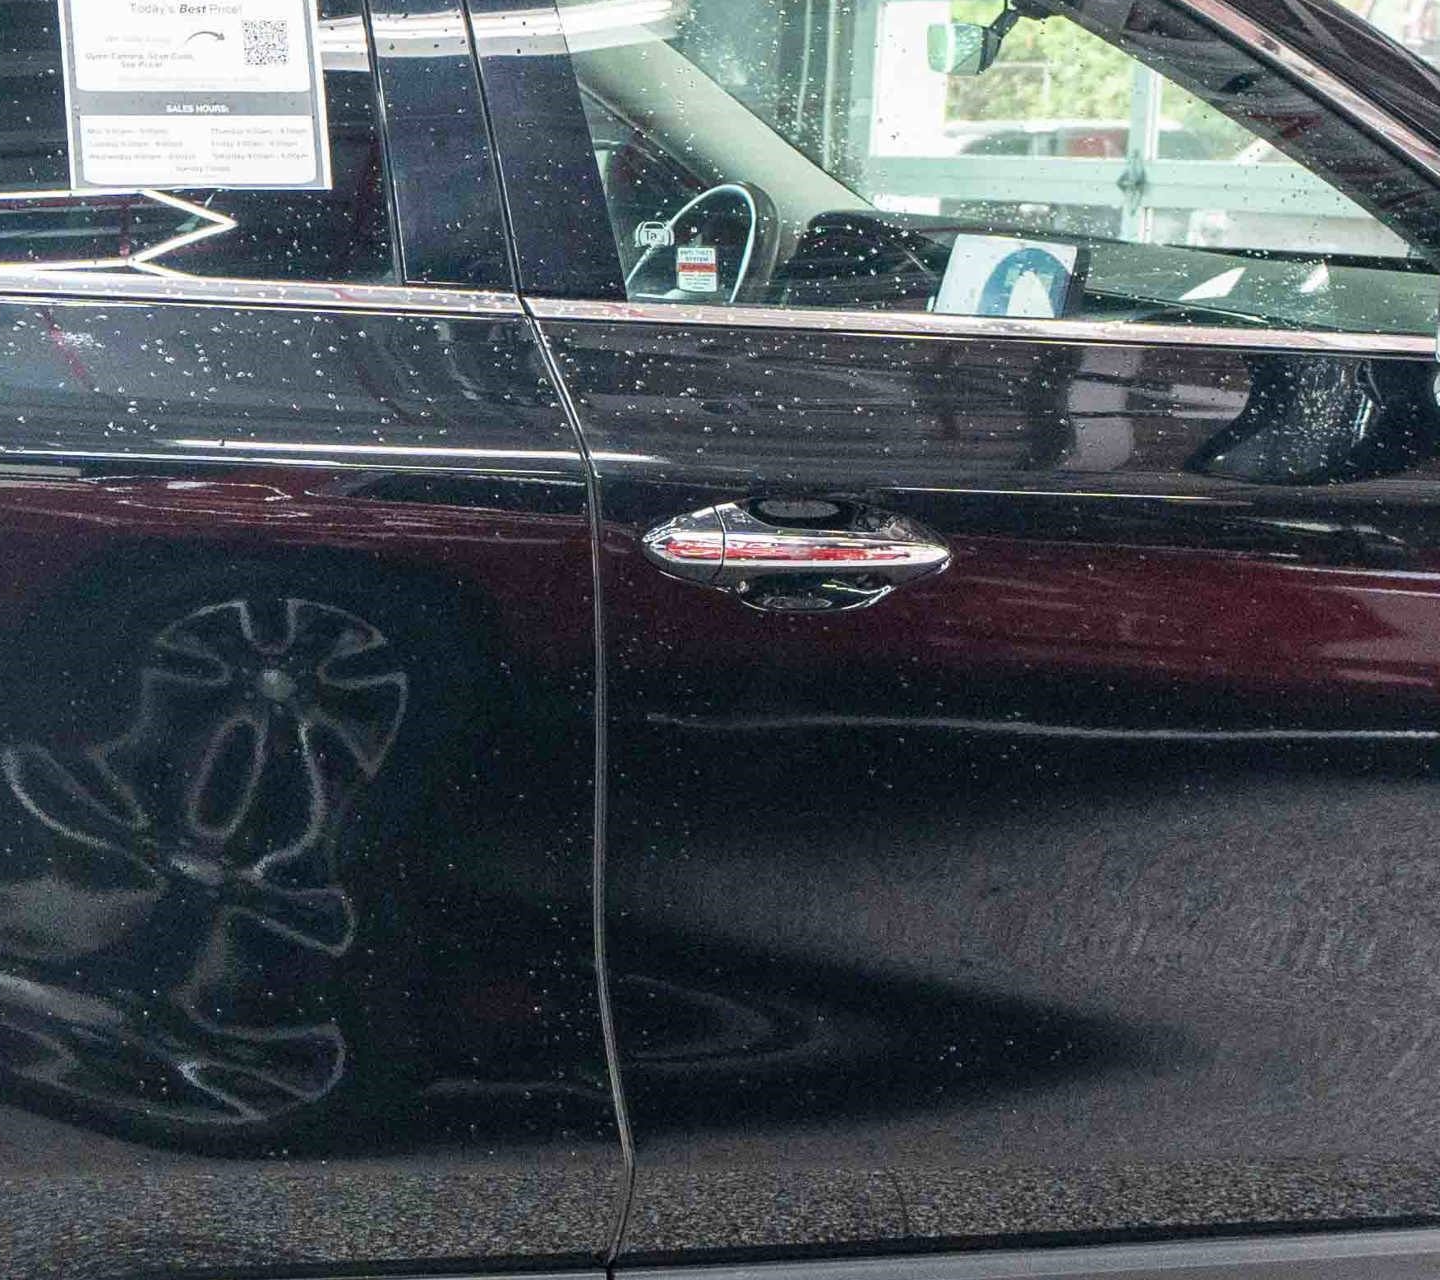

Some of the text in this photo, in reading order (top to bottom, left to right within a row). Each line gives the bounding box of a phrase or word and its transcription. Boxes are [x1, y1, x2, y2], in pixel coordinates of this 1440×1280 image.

[130, 2, 242, 16] Today's Best Price!
[166, 105, 194, 113] SALES
